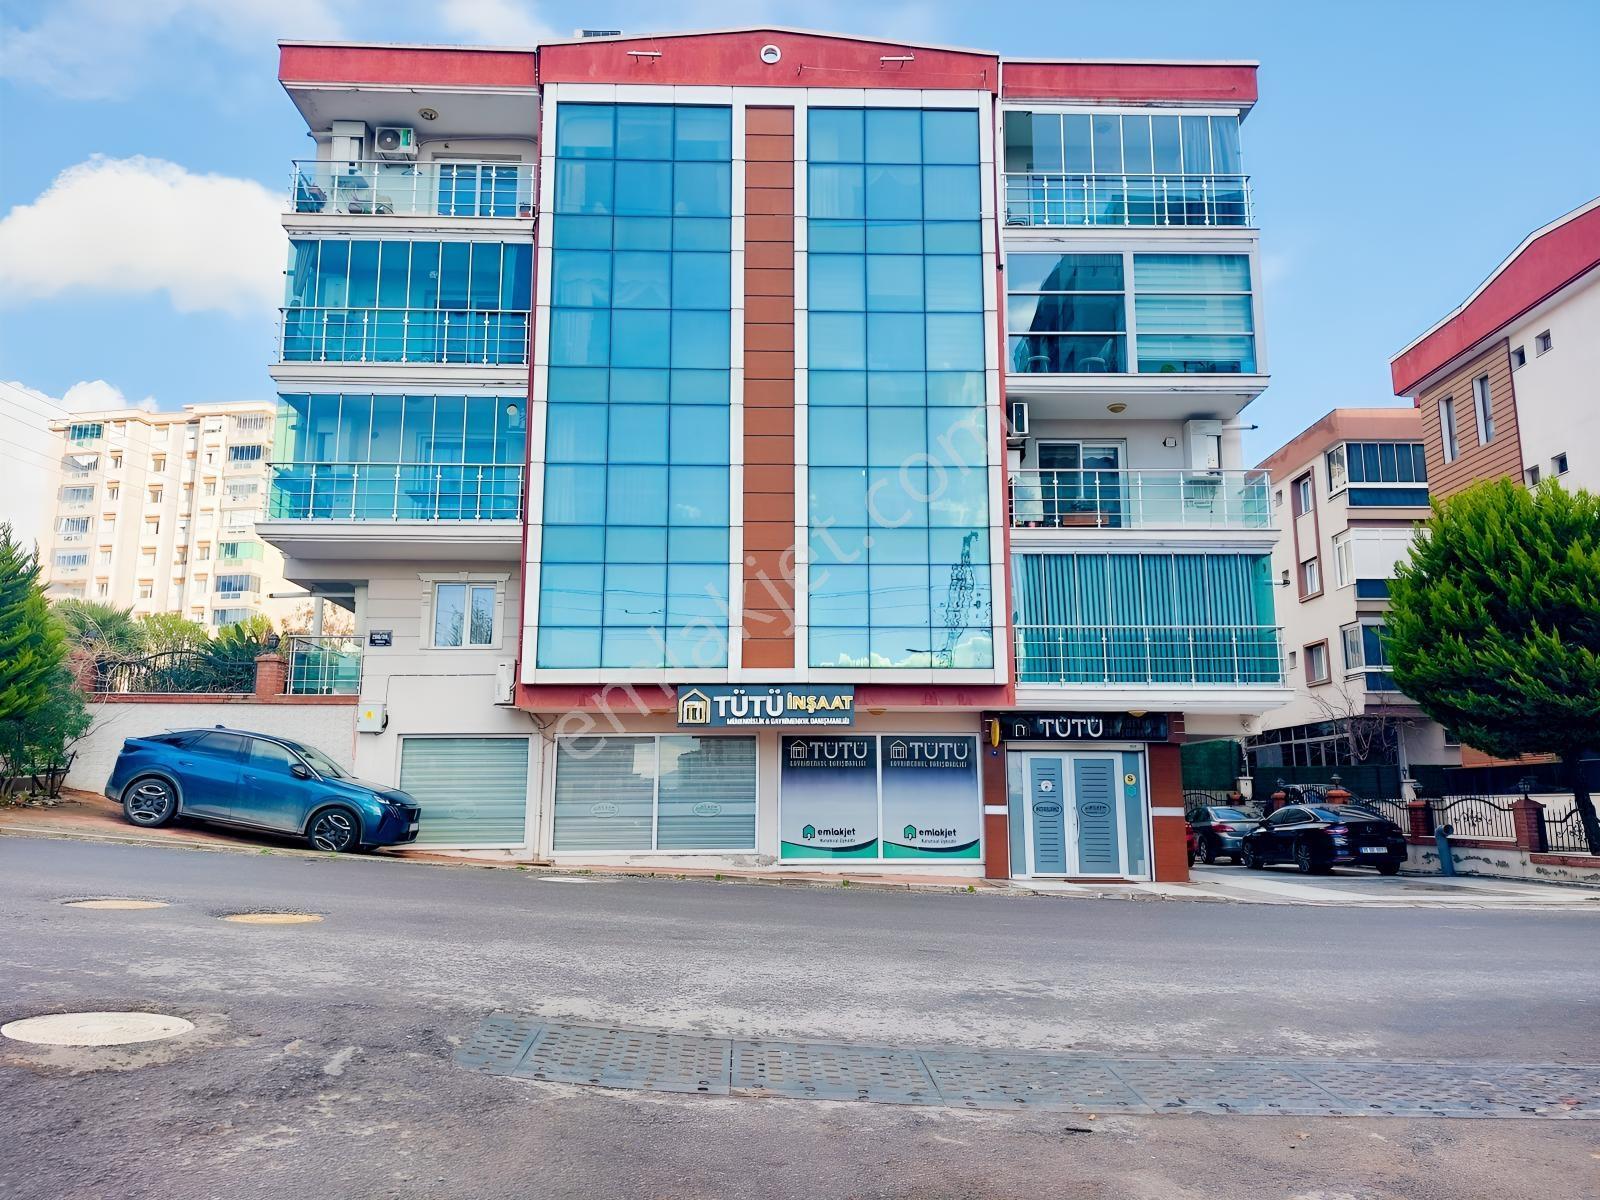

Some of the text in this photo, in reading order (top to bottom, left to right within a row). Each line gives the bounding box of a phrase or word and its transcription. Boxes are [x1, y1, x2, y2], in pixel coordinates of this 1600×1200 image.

[713, 688, 853, 717] TÜTÜ İNŞAAT
[1039, 718, 1103, 738] TÜTÜ
[810, 742, 867, 759] TÜTÜ
[910, 742, 968, 760] TÜTÜ
[817, 827, 856, 837] emlakjet
[919, 828, 957, 838] emlakjet
